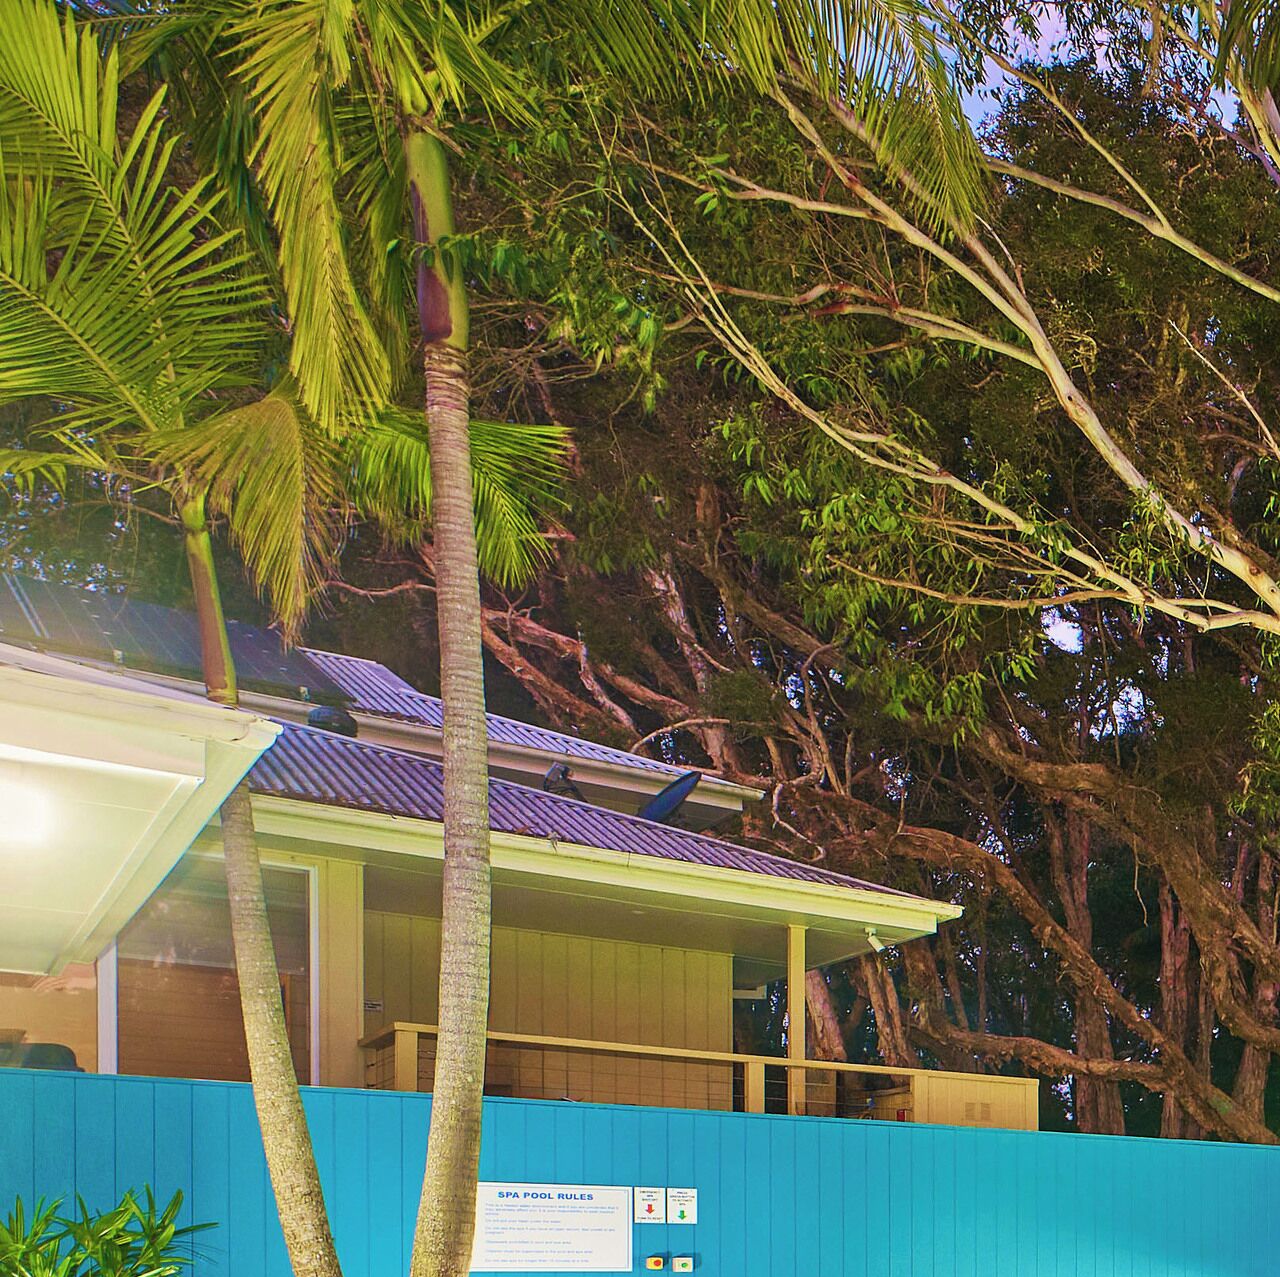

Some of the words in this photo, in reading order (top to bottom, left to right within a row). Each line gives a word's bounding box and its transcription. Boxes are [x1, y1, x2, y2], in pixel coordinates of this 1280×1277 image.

[497, 1191, 520, 1199] SPA
[523, 1192, 554, 1200] POOL
[557, 1193, 594, 1201] RULES
